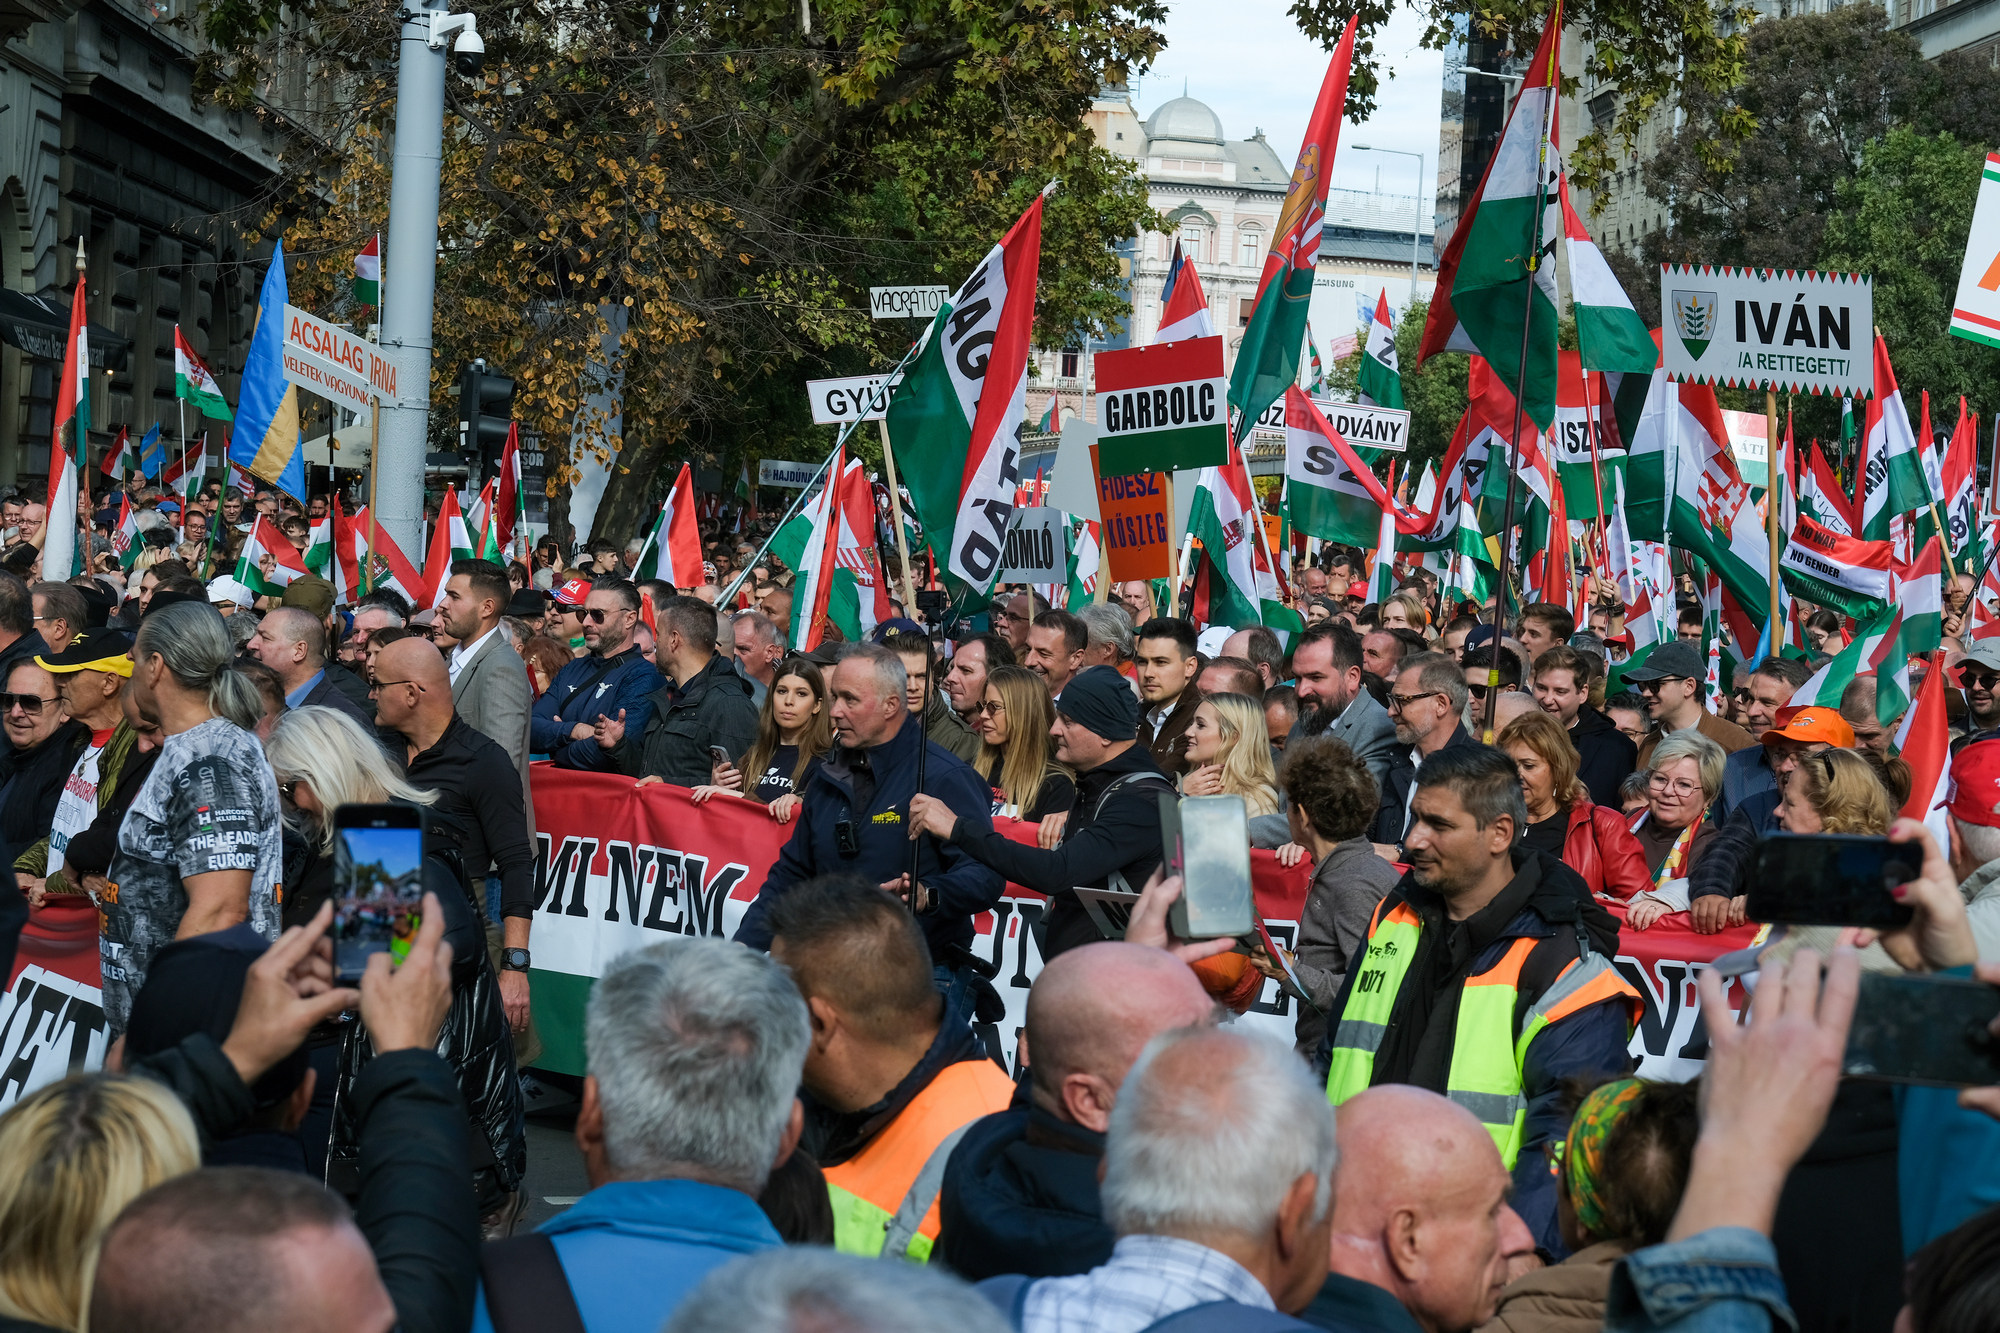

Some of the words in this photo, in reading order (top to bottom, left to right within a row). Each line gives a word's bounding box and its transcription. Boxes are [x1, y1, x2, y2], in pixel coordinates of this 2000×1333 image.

[1735, 293, 1850, 350] IVÁN
[290, 316, 363, 374] ACSALAG
[283, 354, 322, 384] VELETEK
[324, 372, 369, 406] VAGYUNK
[1106, 382, 1215, 433] GARBOLC
[1739, 440, 1765, 456] ÁTI
[1100, 473, 1160, 502] FIDESZ
[1106, 512, 1168, 549] KŐSZEG
[1799, 524, 1814, 540] NO
[1813, 531, 1837, 550] WAR
[1790, 549, 1804, 564] NO
[1805, 556, 1840, 579] GENDER
[189, 834, 215, 852] THE
[227, 844, 238, 853] OF
[208, 853, 256, 870] EUROPE
[533, 837, 598, 918] MI
[604, 844, 746, 940] NEM
